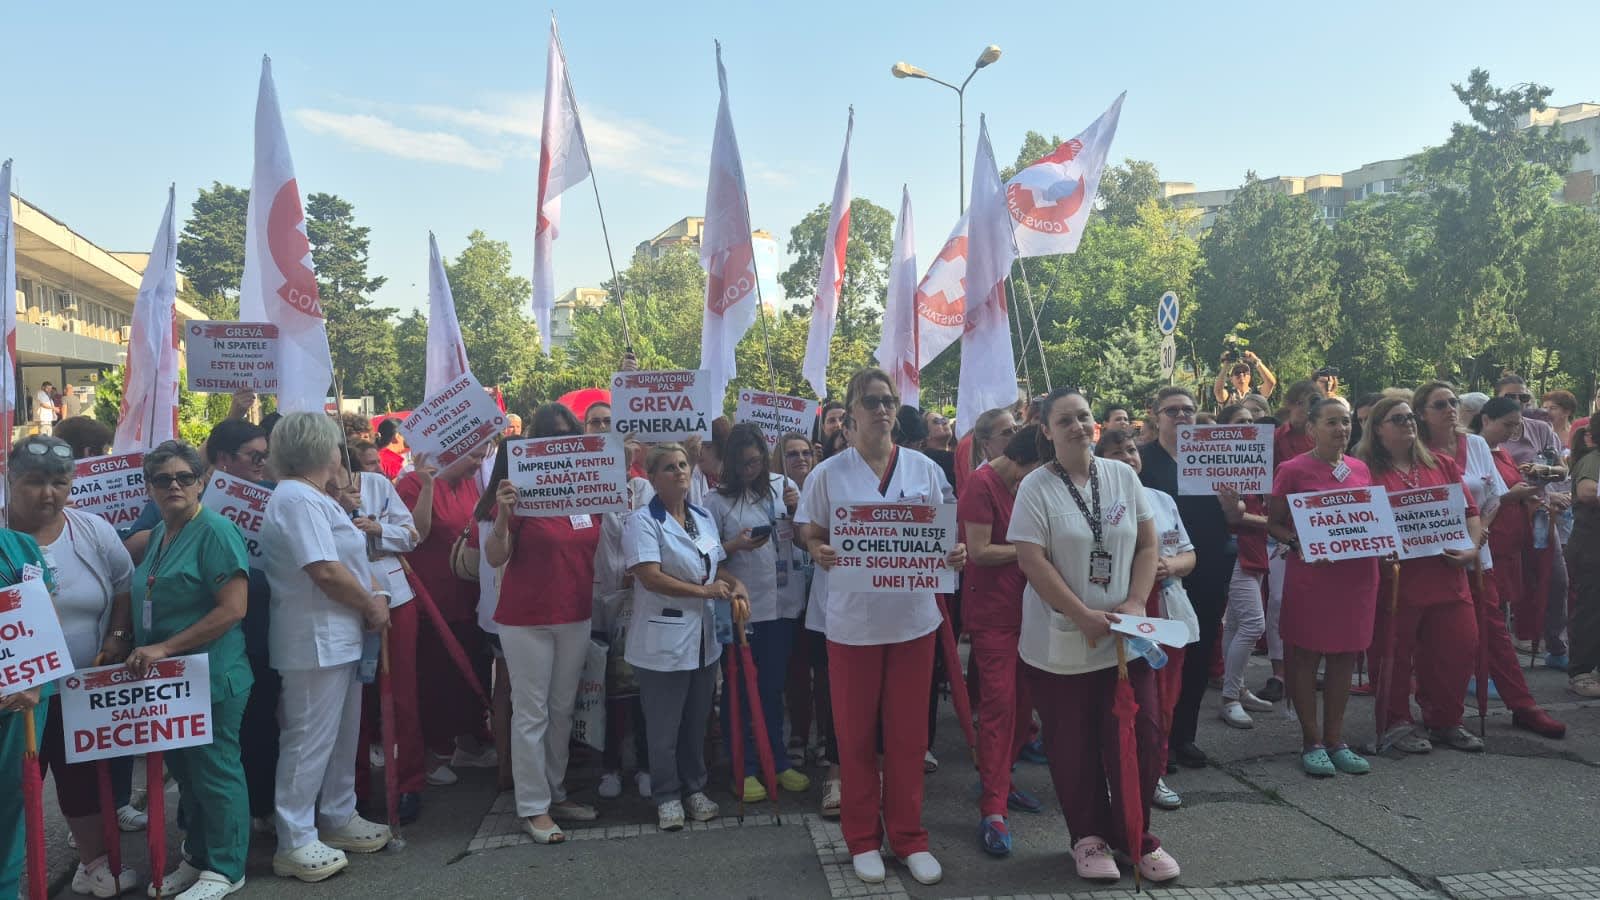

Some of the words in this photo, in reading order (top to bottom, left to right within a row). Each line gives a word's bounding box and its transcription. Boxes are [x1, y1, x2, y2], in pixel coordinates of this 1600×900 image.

[227, 341, 268, 350] SPATELE
[210, 360, 236, 370] ESTE
[238, 361, 254, 370] UN
[257, 361, 274, 370] OM
[195, 378, 248, 389] SISTEMUL
[428, 378, 470, 409] SISTEMUL
[450, 400, 472, 416] ESTE
[629, 396, 694, 412] GREVA
[438, 414, 452, 426] UN
[616, 412, 707, 434] GENERALĂ
[422, 424, 438, 437] OM
[440, 424, 472, 448] SPATELE
[546, 439, 586, 453] GREVĂ
[1180, 442, 1232, 452] SĂNĂTATEA
[1235, 444, 1247, 452] NU
[1248, 444, 1266, 452] ESTE
[90, 456, 130, 473] GREVĂ
[518, 457, 573, 472] ÎMPREUNĂ
[576, 457, 614, 468] PENTRU
[1187, 455, 1196, 464] O
[536, 470, 600, 486] SĂNĂTATE
[1183, 468, 1202, 476] ESTE
[71, 480, 102, 496] DATĂ
[126, 473, 144, 486] ER
[519, 484, 574, 498] ÎMPREUNĂ
[577, 483, 616, 494] PENTRU
[76, 496, 100, 508] CUM
[103, 492, 117, 504] NE
[576, 492, 624, 508] SOCIALĂ
[1321, 492, 1357, 505] GREVĂ
[1400, 489, 1435, 504] GREVĂ
[98, 506, 140, 525] VAR
[220, 506, 264, 532] GRE
[872, 506, 914, 520] GREVĂ
[1310, 510, 1346, 527] FĂRĂ
[1348, 511, 1379, 523] NOI,
[1394, 510, 1440, 522] ĂNĂTATEA
[834, 522, 898, 536] SĂNĂTATEA
[902, 528, 918, 537] NU
[922, 528, 946, 538] ESTE
[1328, 526, 1368, 537] SISTEMUL
[1398, 523, 1427, 534] TENȚA
[1429, 515, 1462, 529] SOCIALĂ
[842, 539, 854, 551] O
[1309, 542, 1327, 555] SE
[1330, 536, 1396, 553] OPREȘTE
[1402, 531, 1439, 547] NGURĂ
[1440, 530, 1465, 542] VOCE
[836, 557, 861, 566] ESTE
[872, 576, 904, 588] UNEI
[907, 571, 939, 591] ȚĂRI
[0, 620, 34, 641] OI,
[0, 651, 61, 688] EȘTE
[111, 664, 160, 682] GRVĂ
[89, 681, 190, 710] RESPECT!
[112, 704, 168, 722] SALARII
[74, 714, 206, 753] DECENTE
